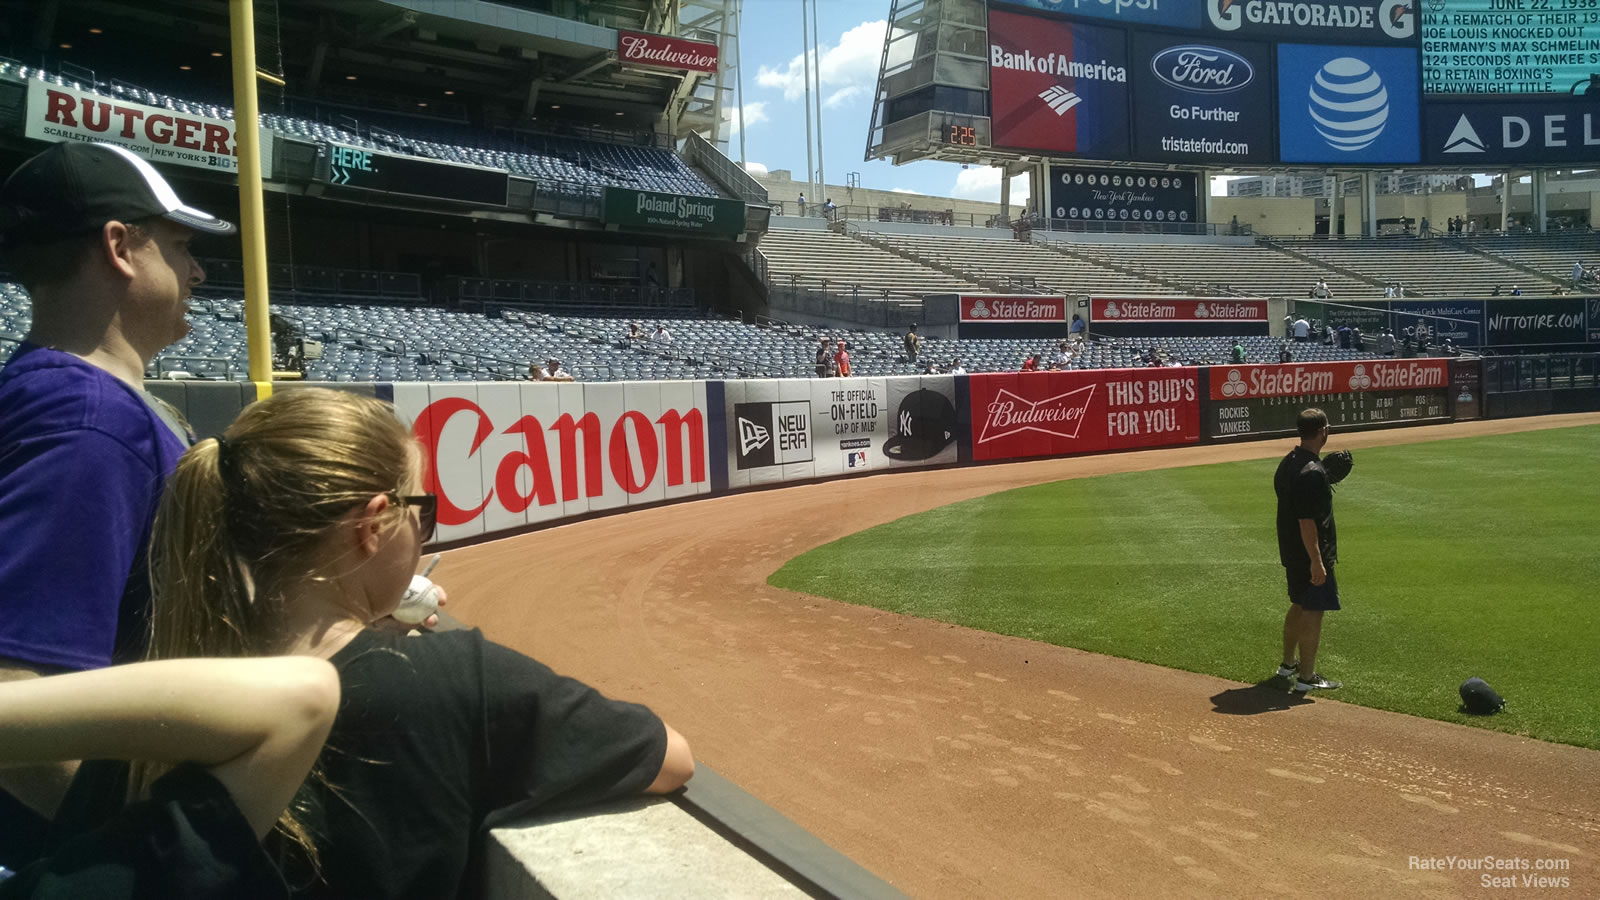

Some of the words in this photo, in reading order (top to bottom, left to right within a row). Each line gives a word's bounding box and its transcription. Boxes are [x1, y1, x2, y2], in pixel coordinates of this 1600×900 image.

[1488, 0, 1525, 10] JUNE
[1530, 0, 1553, 11] 22,
[1560, 0, 1597, 9] 1938
[1246, 0, 1374, 29] GATORADE
[1424, 15, 1437, 25] IN
[1441, 15, 1450, 25] A
[1453, 14, 1513, 25] REMATCH
[1517, 14, 1533, 25] OF
[1538, 14, 1577, 24] THEIR
[1583, 12, 1600, 24] 19
[1424, 28, 1447, 39] JOE
[1450, 28, 1488, 39] LOUIS
[1492, 27, 1554, 38] KNOCKED
[1558, 26, 1585, 38] OUT
[622, 37, 717, 67] Budweiser
[1424, 42, 1497, 53] GERMANY'S
[1501, 41, 1527, 52] MAX
[991, 44, 1036, 72] Bank
[1038, 53, 1055, 74] of
[1057, 55, 1126, 82] America
[1425, 55, 1448, 66] 124
[1452, 55, 1511, 66] SECONDS
[1516, 54, 1530, 66] AT
[1534, 54, 1585, 65] YANKEE
[1172, 52, 1234, 85] Ford
[1424, 69, 1441, 80] TO
[1446, 69, 1490, 80] RETAIN
[1494, 68, 1554, 80] BOXING'S
[1426, 82, 1514, 94] HEAVYWEIGHT
[1518, 82, 1557, 93] TITLE.
[1170, 105, 1189, 119] Go
[1192, 106, 1240, 122] Further
[45, 89, 238, 157] RUTGER
[951, 126, 976, 146] 2:25
[155, 148, 174, 158] NEW
[1162, 136, 1248, 155] tristateford.com
[1092, 190, 1107, 200] New
[1109, 190, 1125, 205] York
[1127, 192, 1154, 205] Yankees
[636, 192, 676, 214] Poland
[678, 197, 714, 222] Spring
[1489, 312, 1584, 331] NITTOTIRE.COM
[832, 391, 844, 402] THE
[847, 390, 876, 402] OFFICIAL
[1106, 381, 1144, 406] THIS
[1148, 379, 1195, 404] BUD'S
[1416, 396, 1426, 404] POS
[830, 403, 878, 421] ON-FIELD
[988, 401, 1084, 428] Budweiser
[1220, 407, 1250, 419] ROCKIES
[1371, 410, 1384, 420] BALL
[1400, 408, 1418, 418] STRIKE
[1429, 406, 1438, 416] OUT
[779, 414, 806, 432] NEW
[835, 423, 848, 435] CAP
[851, 422, 859, 433] OF
[1108, 412, 1140, 436] FOR
[1144, 408, 1181, 434] YOU.
[1220, 421, 1251, 434] YANKEES
[780, 432, 807, 450] ERA
[413, 397, 706, 526] Canon
